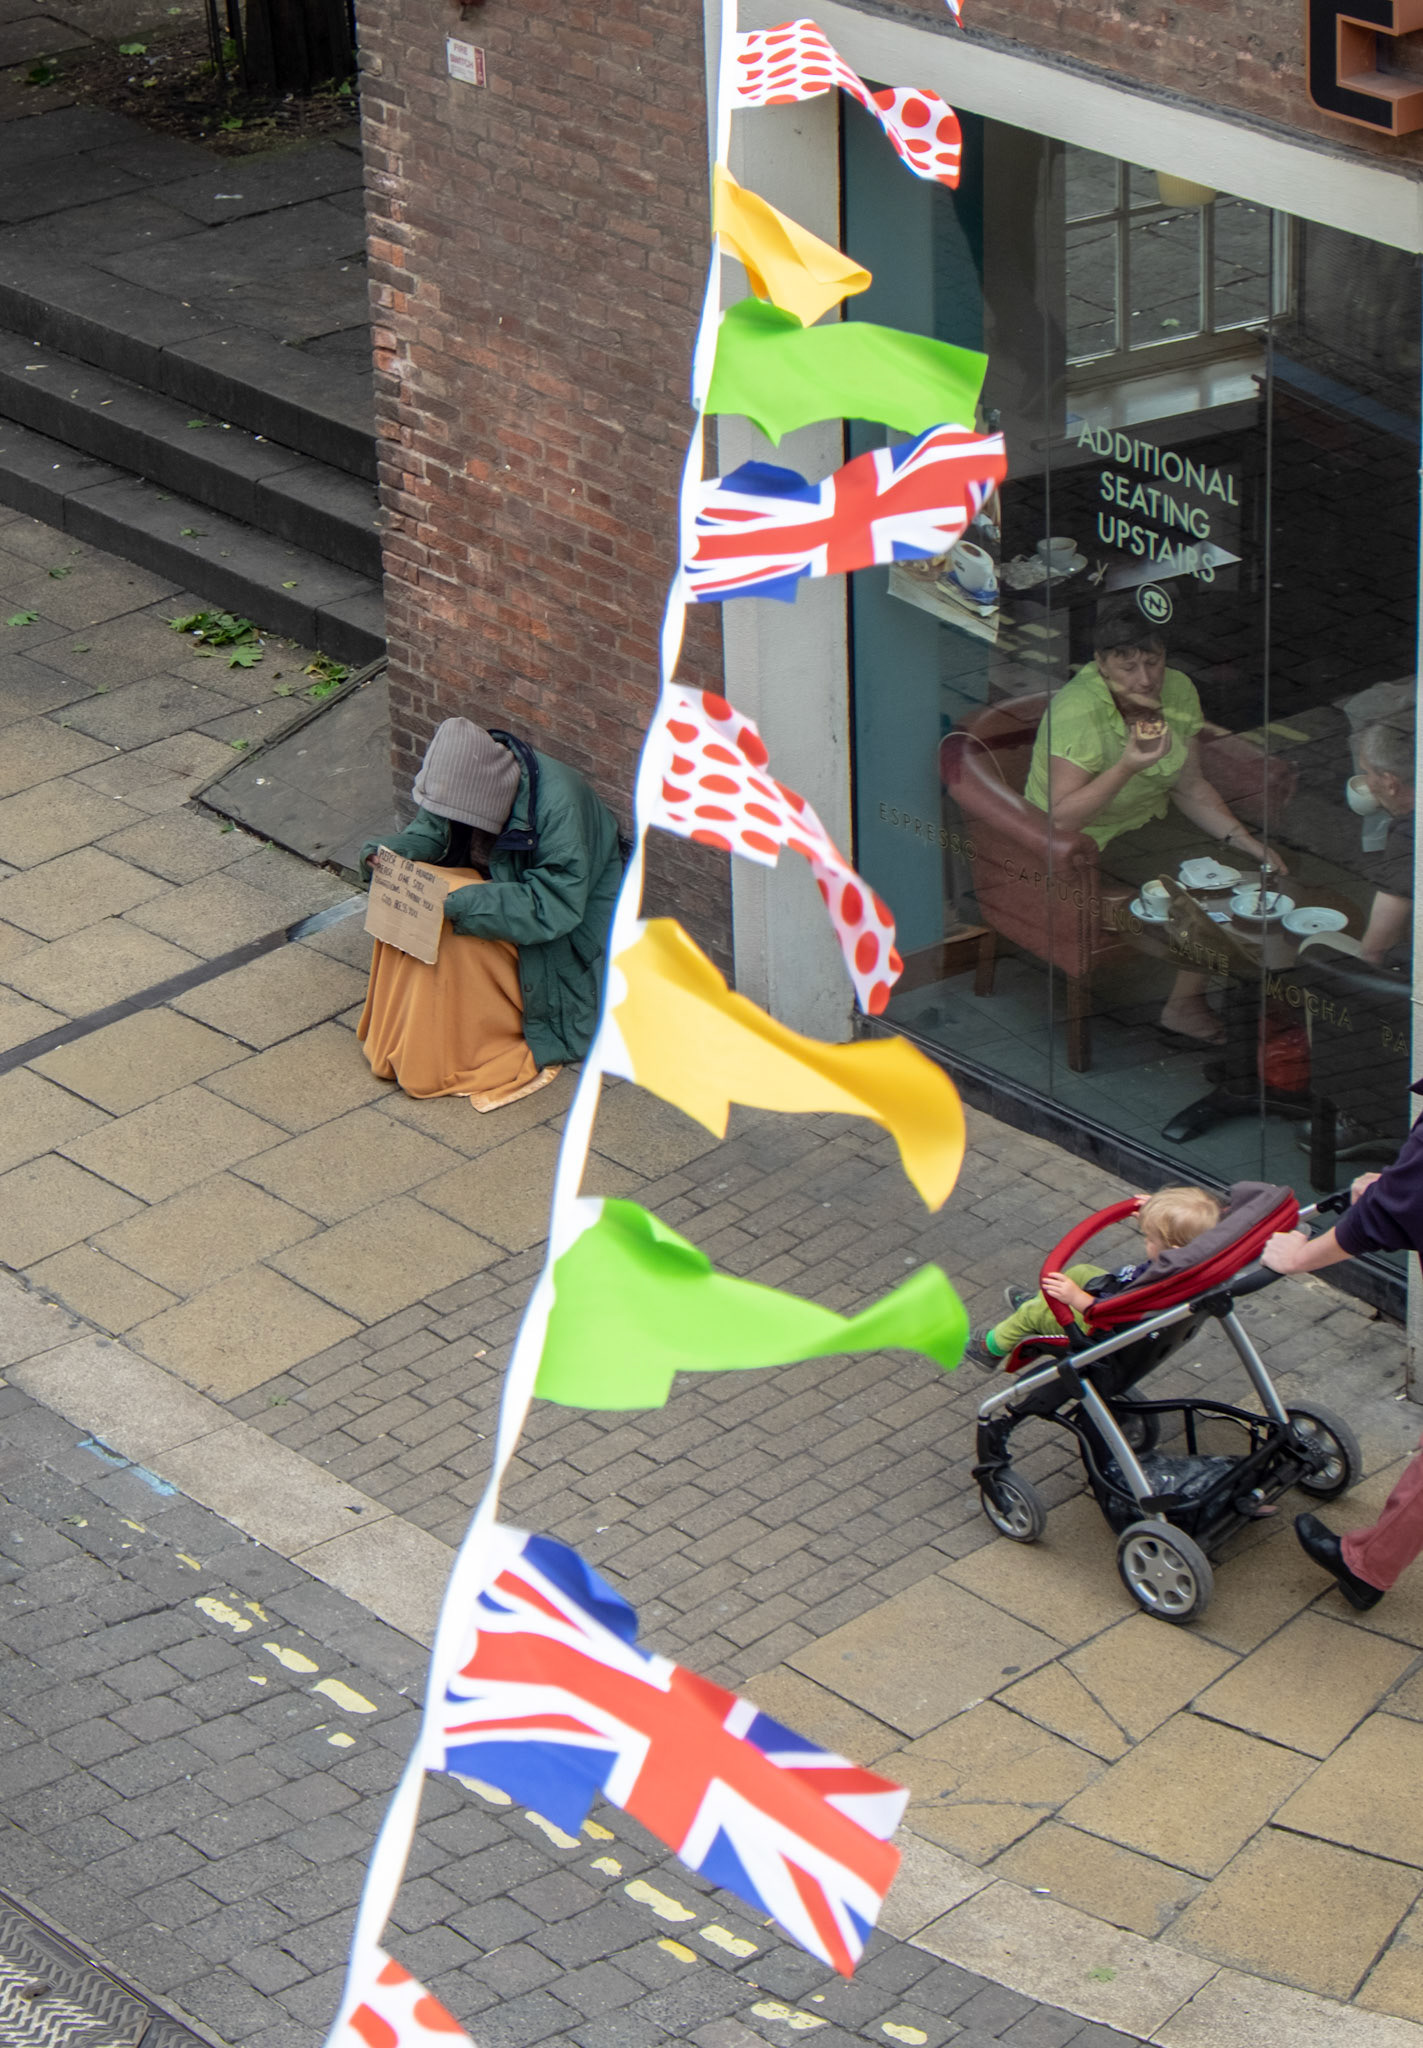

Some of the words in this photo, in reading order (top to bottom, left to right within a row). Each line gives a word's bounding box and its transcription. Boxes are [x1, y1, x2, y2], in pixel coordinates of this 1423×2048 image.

[1077, 420, 1239, 506] ADDITIONAL
[1100, 470, 1211, 540] SEATING
[1098, 511, 1216, 583] UPSTAIRS
[879, 802, 978, 861] ESPRESSO
[1003, 859, 1144, 936] CAPPUCCINO
[1169, 933, 1230, 977] LATTE
[1265, 971, 1354, 1032] MOCHA
